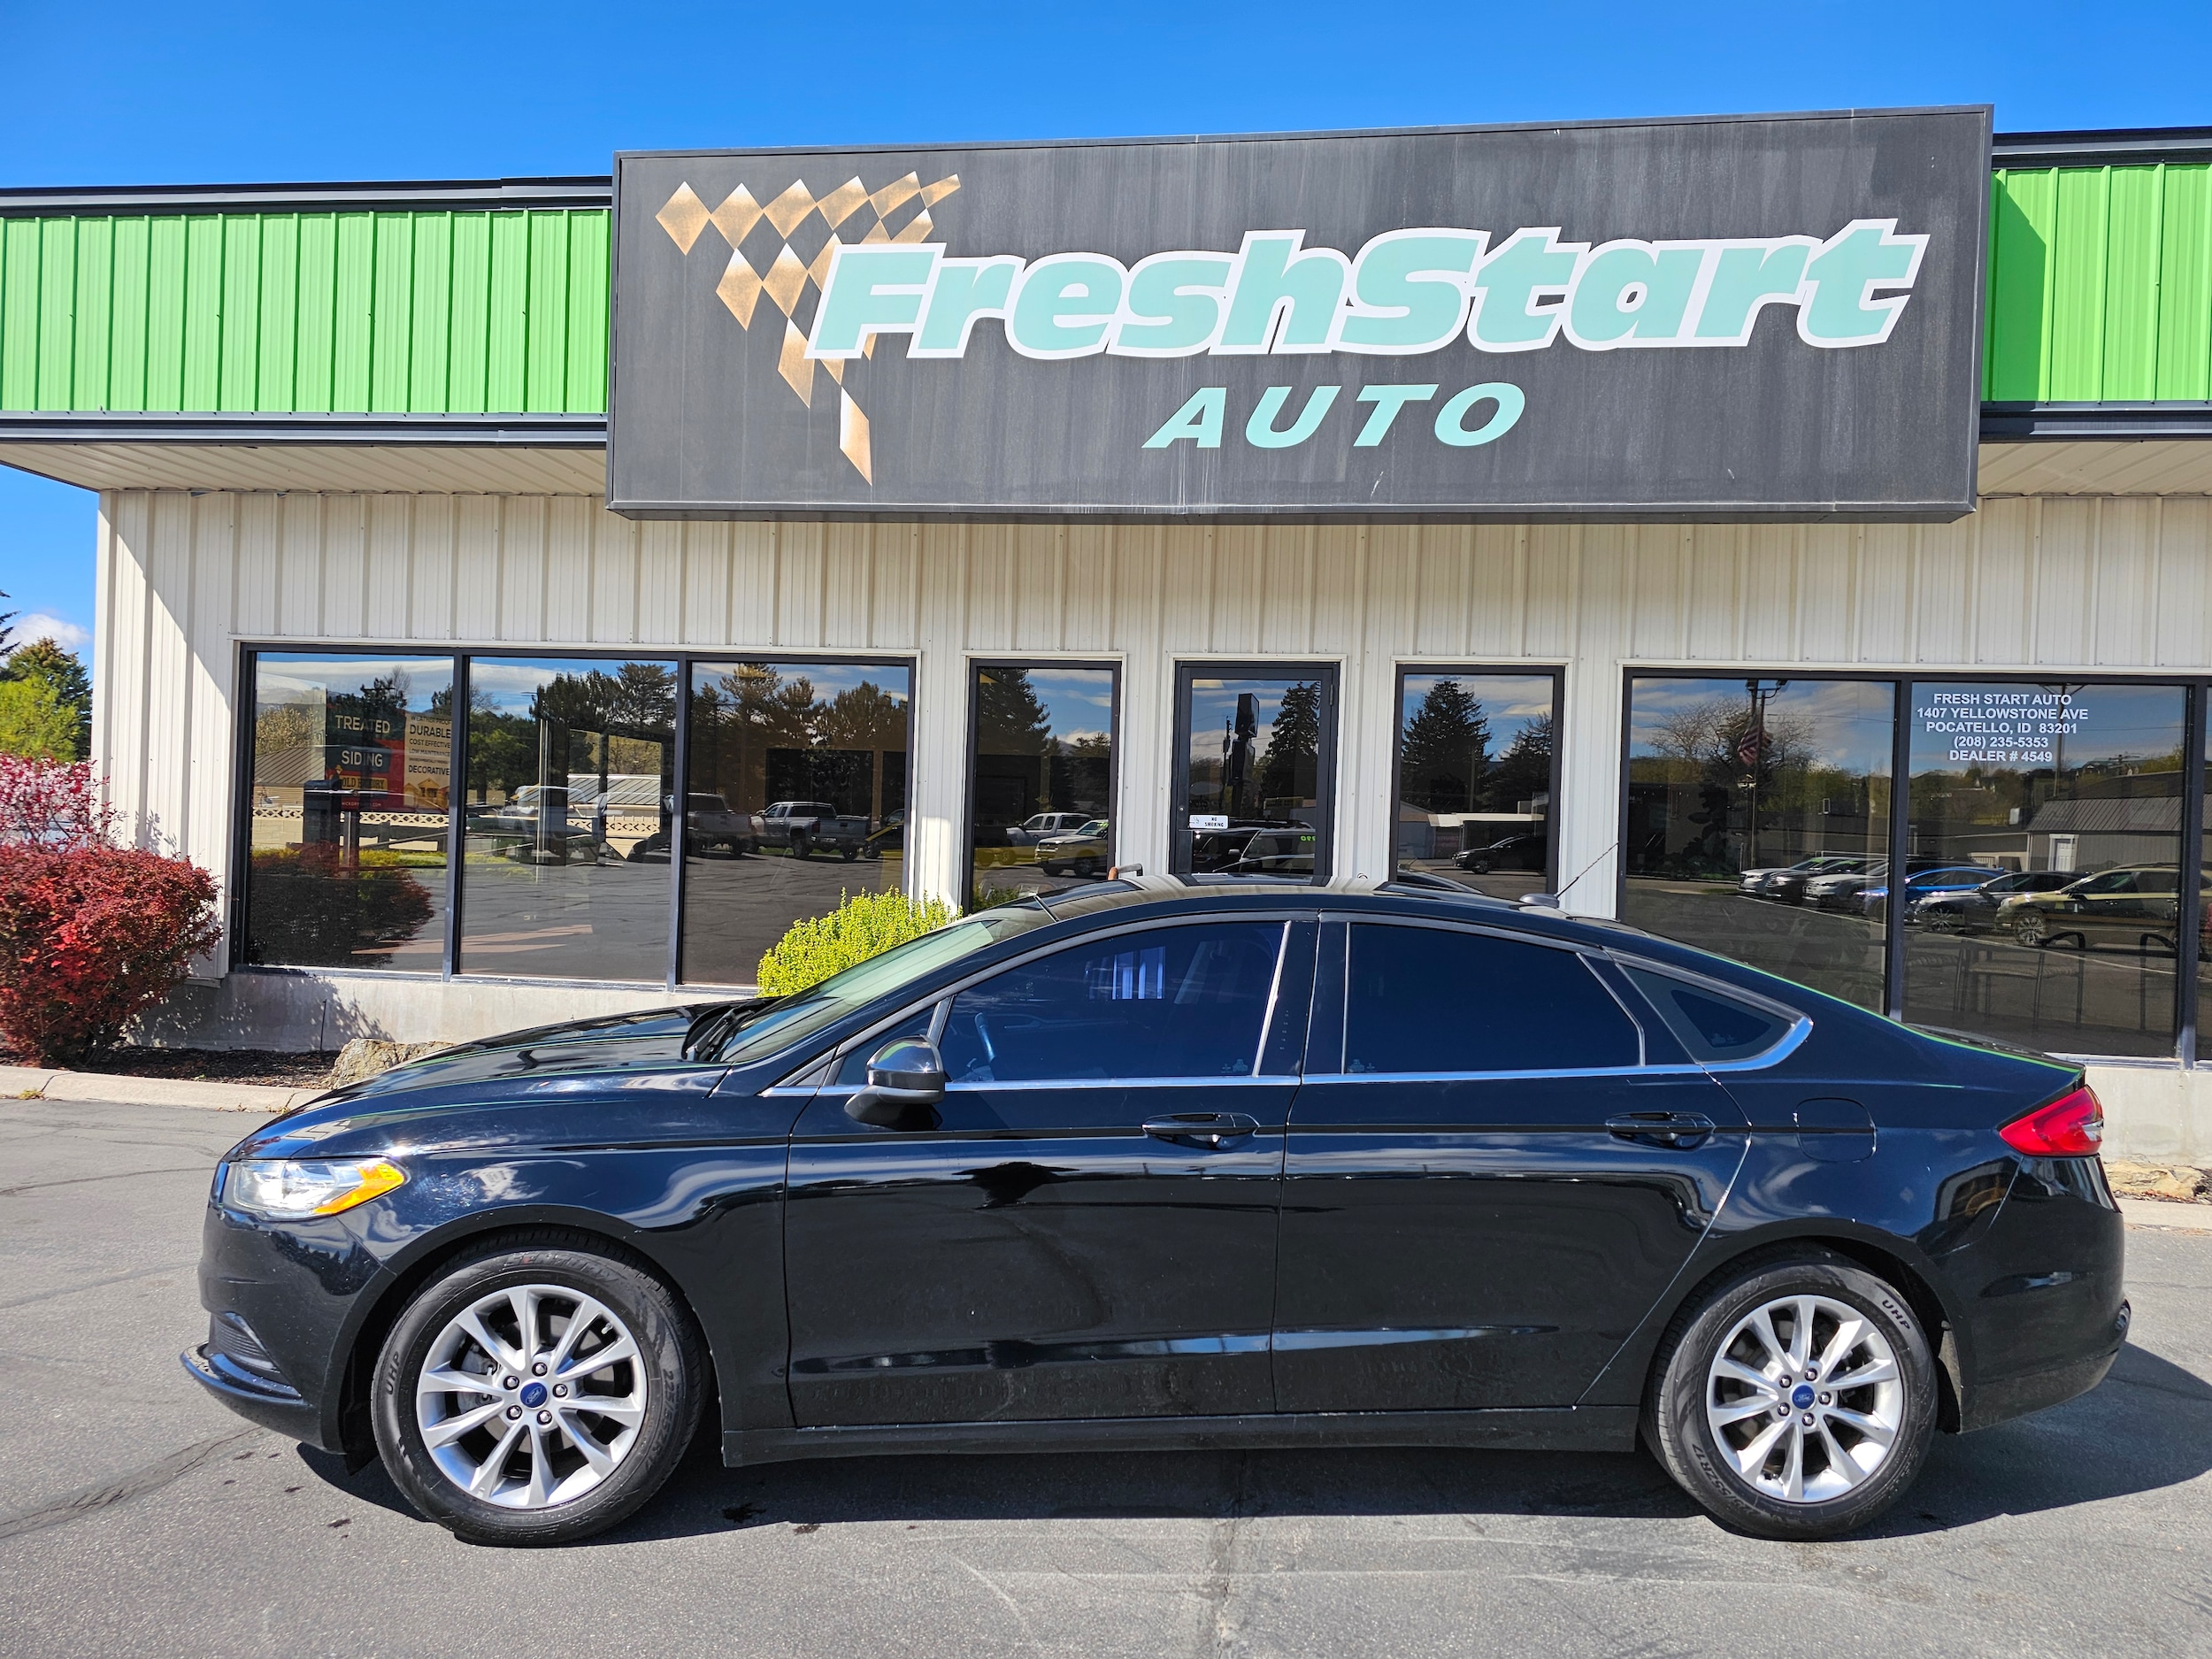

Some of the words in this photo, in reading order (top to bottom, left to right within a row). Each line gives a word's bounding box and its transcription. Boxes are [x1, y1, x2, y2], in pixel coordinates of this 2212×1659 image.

[803, 217, 1930, 361] FreshStart
[1141, 382, 1525, 449] AUTO
[1933, 694, 1980, 704] FRESH
[1984, 694, 2030, 705] START
[2032, 695, 2072, 705] AUTO
[1916, 708, 1947, 718] 1407
[1950, 708, 2057, 719] YELLOWSTONE
[2060, 709, 2089, 719] AVE
[334, 715, 391, 734] TREATED
[1926, 722, 2013, 734] POCATELLO,
[2018, 723, 2032, 733] ID
[2039, 723, 2077, 734] 83201
[410, 724, 451, 739] DURABLE
[425, 740, 451, 749] EFFECTIVE
[1954, 736, 1986, 749] (208)
[1990, 737, 2049, 749] 235-5353
[342, 750, 383, 768] SIDING
[1949, 750, 2007, 762] DEALER
[2008, 751, 2018, 762] #
[2021, 751, 2053, 763] 4549
[408, 764, 450, 776] DECORATIVE
[342, 777, 357, 787] OLD
[1882, 1299, 1910, 1330] UHP
[386, 1350, 399, 1395] UHP
